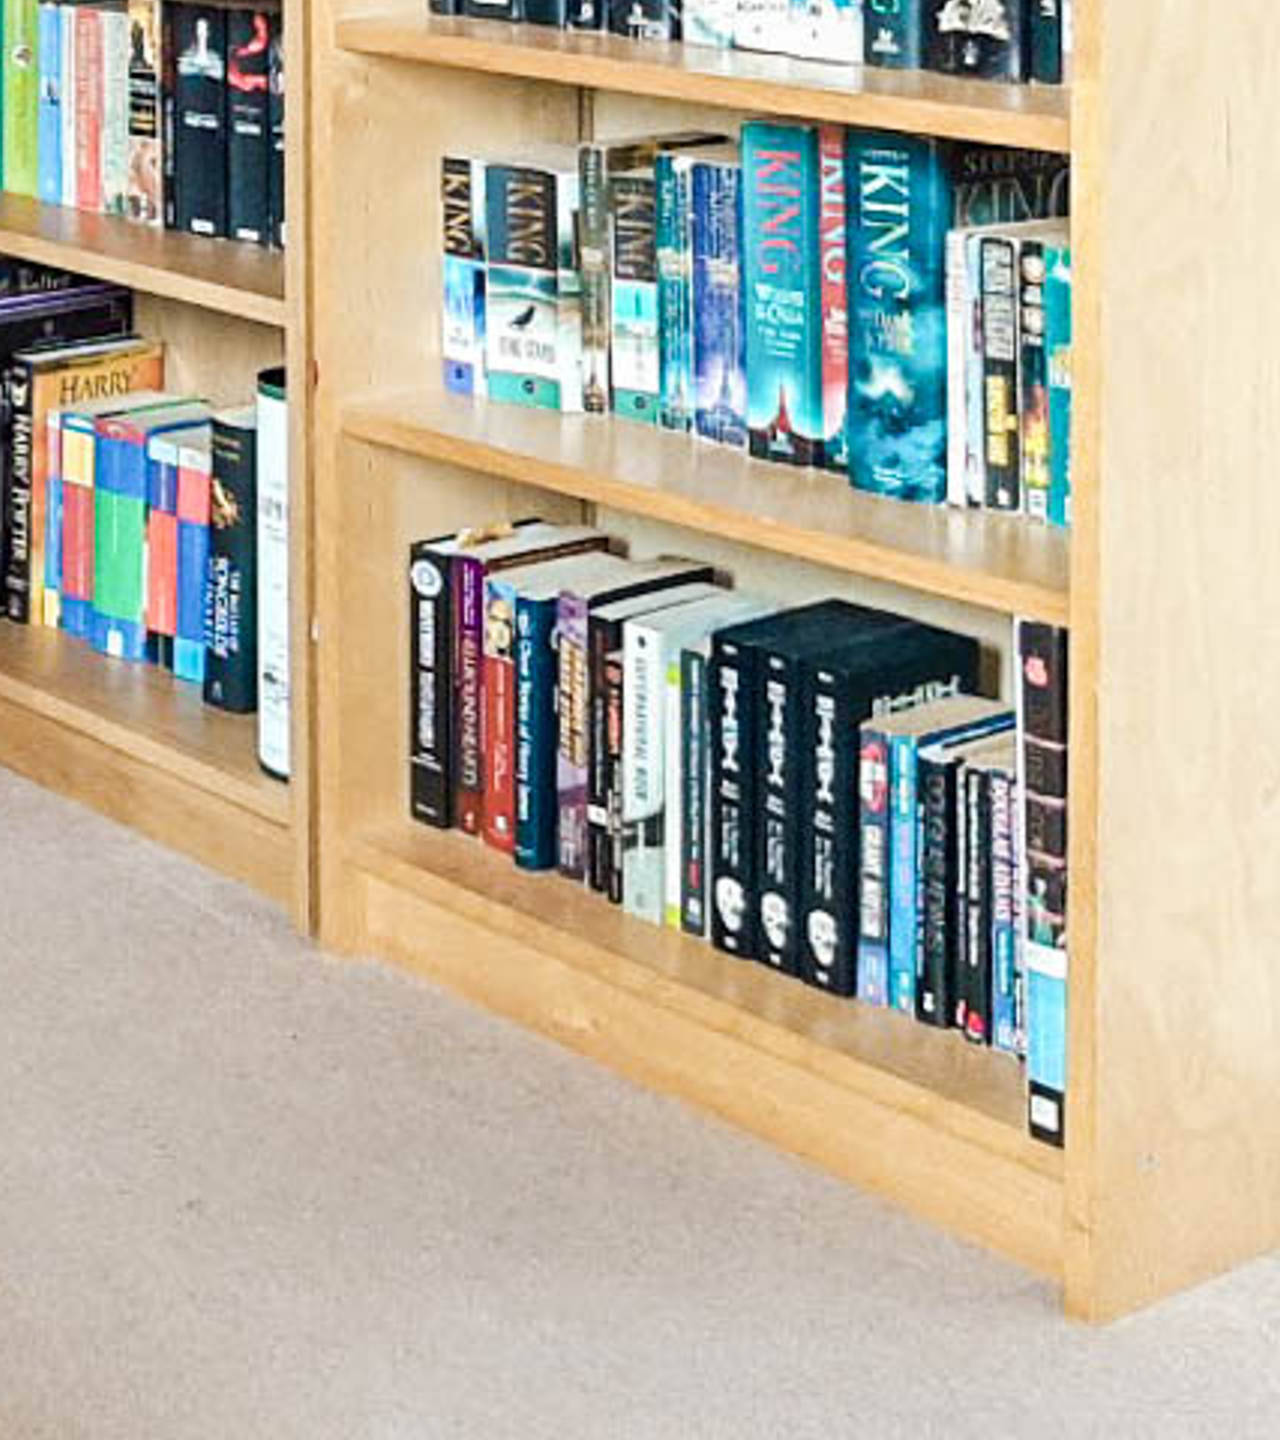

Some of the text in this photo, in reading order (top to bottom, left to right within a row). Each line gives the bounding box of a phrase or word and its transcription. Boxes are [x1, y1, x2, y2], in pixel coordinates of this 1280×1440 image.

[442, 176, 472, 254] KING
[506, 181, 546, 264] KING
[754, 148, 801, 274] KING
[860, 164, 911, 302] KING
[59, 371, 132, 406] HARRY
[12, 413, 33, 485] HARRY
